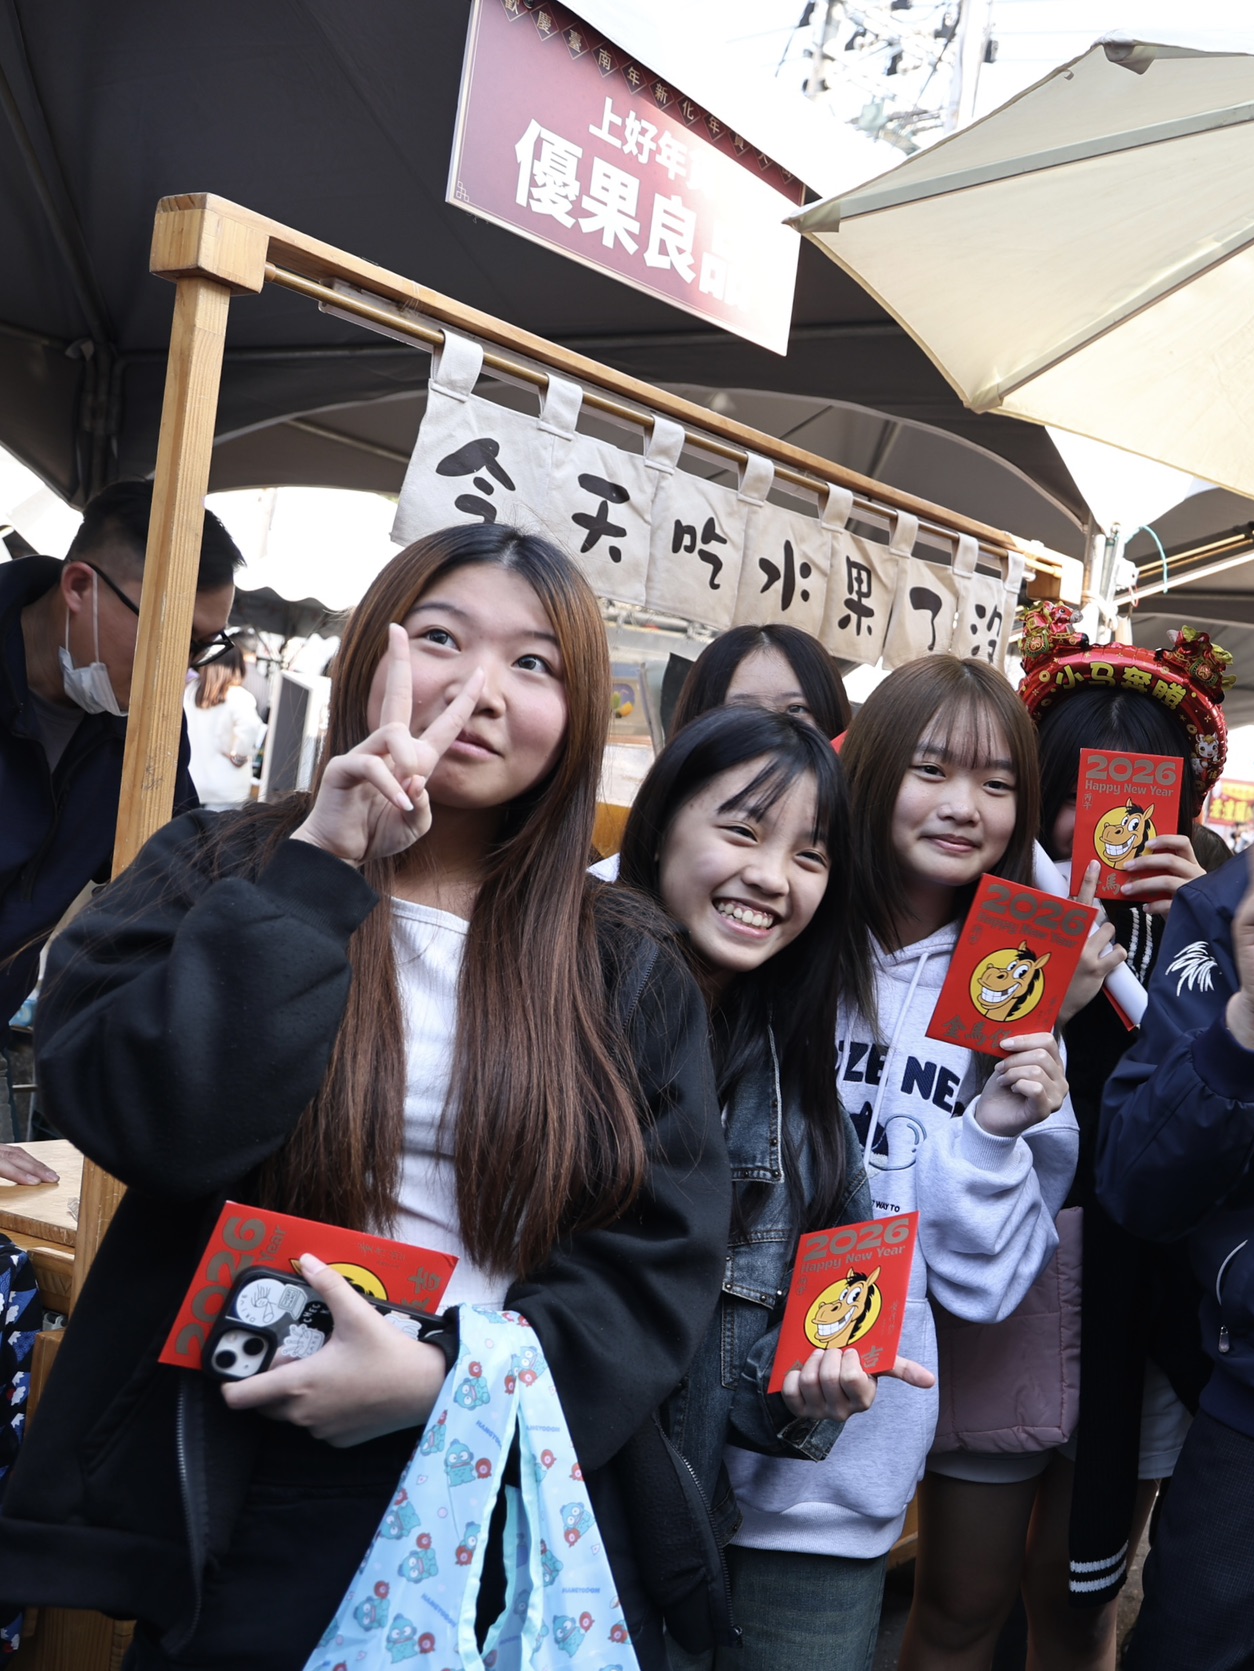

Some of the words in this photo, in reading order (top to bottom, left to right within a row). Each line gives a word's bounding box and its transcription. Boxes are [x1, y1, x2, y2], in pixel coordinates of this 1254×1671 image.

[1084, 754, 1177, 787] 2026
[1084, 779, 1121, 795] Happy
[1123, 783, 1147, 795] New
[1149, 784, 1174, 798] Year
[980, 884, 1089, 937] 2026
[977, 912, 1018, 935] Happy
[1020, 924, 1048, 940] New
[1050, 932, 1079, 949] Year
[942, 1015, 1014, 1050] 金馬伍
[900, 1055, 966, 1118] NE
[890, 1203, 901, 1213] TO
[257, 1225, 288, 1263] Year
[802, 1218, 910, 1262] 2026
[801, 1258, 842, 1274] Happy
[845, 1252, 873, 1264] New
[876, 1245, 906, 1258] Year
[174, 1215, 267, 1356] 2026
